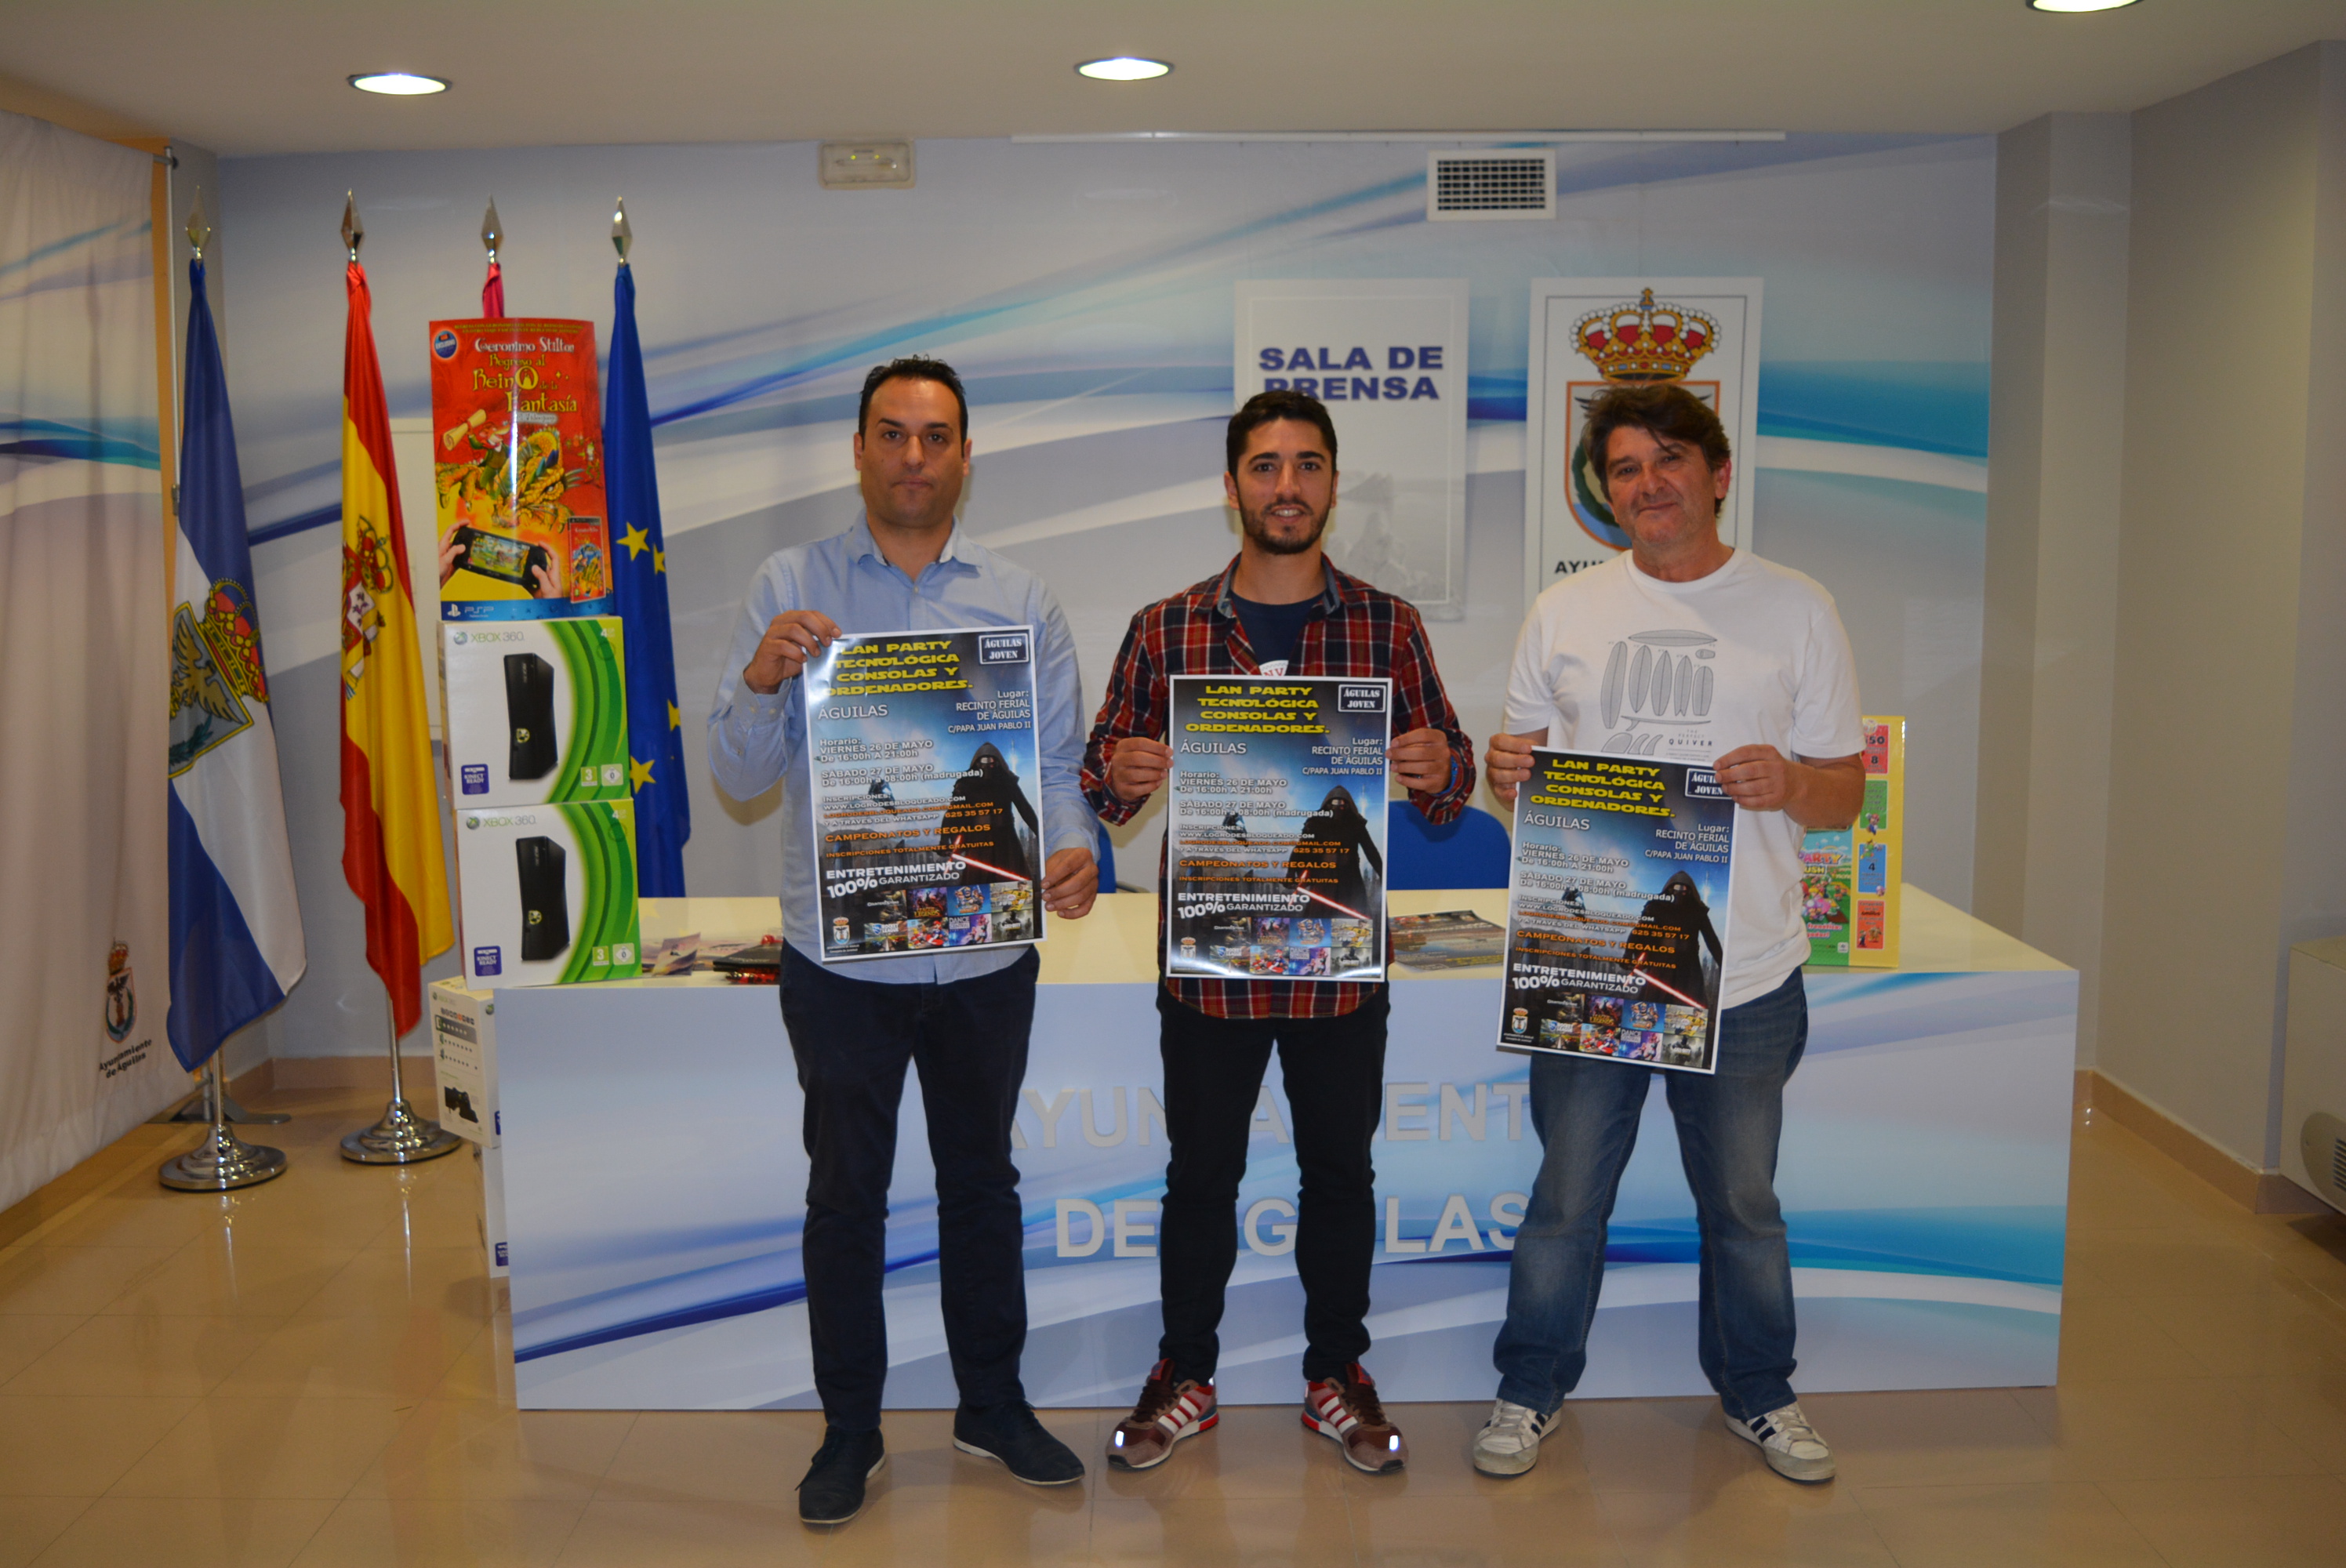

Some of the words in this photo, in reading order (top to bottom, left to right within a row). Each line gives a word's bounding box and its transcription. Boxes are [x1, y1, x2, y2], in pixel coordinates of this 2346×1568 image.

[474, 337, 536, 352] Geronimo
[539, 336, 575, 353] Stilton
[489, 354, 532, 371] Regreso
[536, 354, 545, 366] al
[1259, 347, 1372, 371] SALA
[1389, 346, 1443, 369] DE
[1265, 376, 1440, 401] PRENSA
[471, 633, 501, 643] XBOX
[503, 631, 525, 641] 360
[985, 637, 1022, 648] ÁGUILAS
[839, 644, 878, 654] LAN
[886, 640, 952, 652] PARTY
[831, 651, 960, 668] TECNOLÓGICA
[989, 650, 1018, 659] JOVEN
[835, 668, 938, 682] CONSOLAS
[945, 666, 959, 676] Y
[997, 689, 1029, 699] Lugar:
[1205, 685, 1241, 694] LAN
[1250, 686, 1312, 695] PARTY
[1344, 688, 1380, 697] ÁGUILAS
[956, 700, 997, 711] RECINTO
[999, 699, 1030, 708] FERIAL
[1197, 695, 1319, 709] TECNOLÓGICA
[816, 701, 888, 720] ÁGUILAS
[977, 711, 989, 720] DE
[992, 707, 1030, 720] ÁGUILAS
[1200, 710, 1296, 720] CONSOLAS
[1303, 712, 1316, 720] Y
[947, 724, 975, 733] C/PAPA
[976, 722, 997, 731] JUAN
[998, 720, 1022, 730] PABLO
[1024, 720, 1030, 728] II
[1185, 722, 1330, 734] ORDENADORES.
[819, 737, 861, 746] Horario:
[819, 744, 866, 754] VIERNES
[884, 742, 899, 750] DE
[902, 740, 933, 749] MAYO
[1180, 739, 1246, 753] ÁGUILAS
[1352, 737, 1382, 746] Lugar:
[837, 752, 871, 761] 16:00h
[884, 749, 918, 758] 21:00h
[1312, 746, 1350, 754] RECINTO
[1353, 746, 1383, 755] FERIAL
[1331, 756, 1342, 764] DE
[1346, 755, 1383, 765] ÁGUILAS
[1871, 756, 1879, 764] 8
[586, 768, 593, 781] 3
[902, 764, 934, 773] MAYO
[1302, 766, 1328, 775] C/PAPA
[1552, 759, 1589, 770] LAN
[1596, 762, 1660, 777] PARTY
[839, 776, 873, 785] 16:00h
[884, 774, 917, 782] 08:00h
[921, 768, 984, 781] (madrugada)
[1543, 768, 1666, 791] TECNOLÓGICA
[1690, 772, 1717, 784] ÁGUI
[1545, 783, 1643, 801] CONSOLAS
[1649, 793, 1663, 803] Y
[1694, 784, 1723, 796] JOVEN
[1530, 793, 1676, 817] ORDENADORES.
[483, 818, 514, 828] XBOX
[515, 815, 536, 826] 360
[1523, 810, 1590, 830] ÁGUILAS
[825, 829, 920, 842] CAMPEONATOS
[934, 823, 991, 834] REGALOS
[1698, 823, 1729, 834] Lugar:
[1655, 828, 1695, 840] RECINTO
[1698, 832, 1729, 844] FERIAL
[826, 848, 891, 858] INSCRIPCIONES
[893, 844, 946, 853] TOTALMENTE
[948, 840, 994, 849] GRATUITAS
[1675, 840, 1687, 850] DE
[1690, 840, 1728, 854] ÁGUILAS
[1644, 848, 1672, 858] C/PAPA
[1673, 851, 1693, 861] JUAN
[1695, 853, 1719, 863] PABLO
[1720, 855, 1727, 864] II
[826, 860, 966, 880] ENTRETENIMIENTO
[1179, 859, 1268, 868] CAMPEONATOS
[1282, 861, 1337, 869] REGALOS
[1868, 862, 1876, 871] 4
[826, 875, 879, 898] 100%
[878, 871, 960, 884] GARANTIZADO
[1177, 891, 1310, 904] ENTRETENIMIENTO
[1177, 900, 1226, 920] 100%
[1226, 902, 1303, 912] GARANTIZADO
[1516, 930, 1605, 947] CAMPEONATOS
[1618, 942, 1675, 955] REGALOS
[597, 948, 604, 960] 3
[1513, 961, 1646, 987] ENTRETENIMIENTO
[1511, 970, 1560, 995] 100%
[1560, 978, 1638, 995] GARANTIZADO
[106, 1069, 117, 1078] de
[1055, 1198, 1159, 1258] DE
[1237, 1192, 1530, 1256] GLAS
